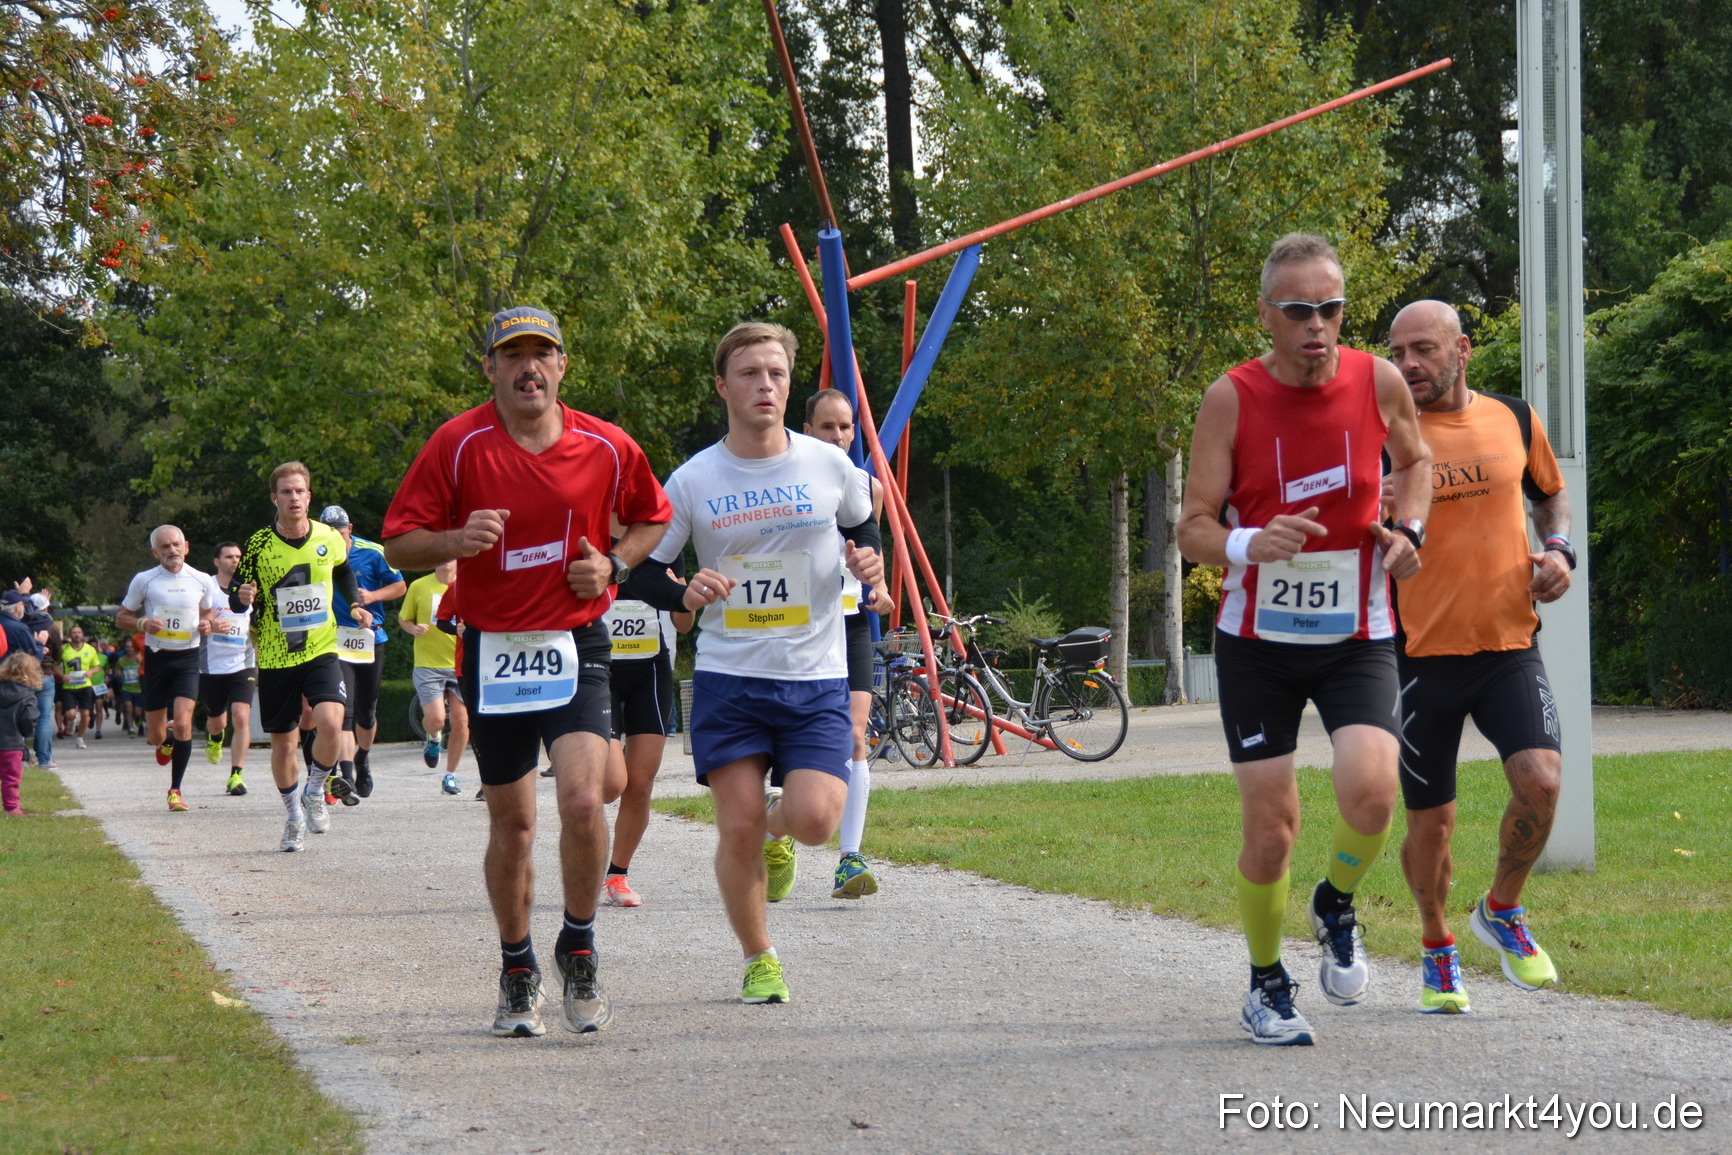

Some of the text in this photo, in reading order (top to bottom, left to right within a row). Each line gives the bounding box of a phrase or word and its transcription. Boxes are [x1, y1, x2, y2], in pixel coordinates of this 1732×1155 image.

[501, 316, 550, 330] BOMAG
[1302, 477, 1329, 492] DEHN
[706, 484, 812, 516] VR BANK
[1461, 488, 1490, 499] VISION
[711, 505, 793, 531] NÜRNBERG
[760, 517, 830, 536] Die Teilhaberbank
[521, 550, 549, 563] DEHN
[741, 578, 789, 604] 174
[1271, 578, 1339, 608] 2151
[286, 597, 322, 615] 2692
[165, 618, 180, 630] 16
[748, 612, 785, 624] Stephan
[1292, 617, 1320, 629] Peter
[611, 618, 646, 637] 262
[343, 638, 365, 650] 405
[617, 642, 640, 650] Larissa
[494, 648, 563, 679] 2449
[515, 685, 542, 697] Josef
